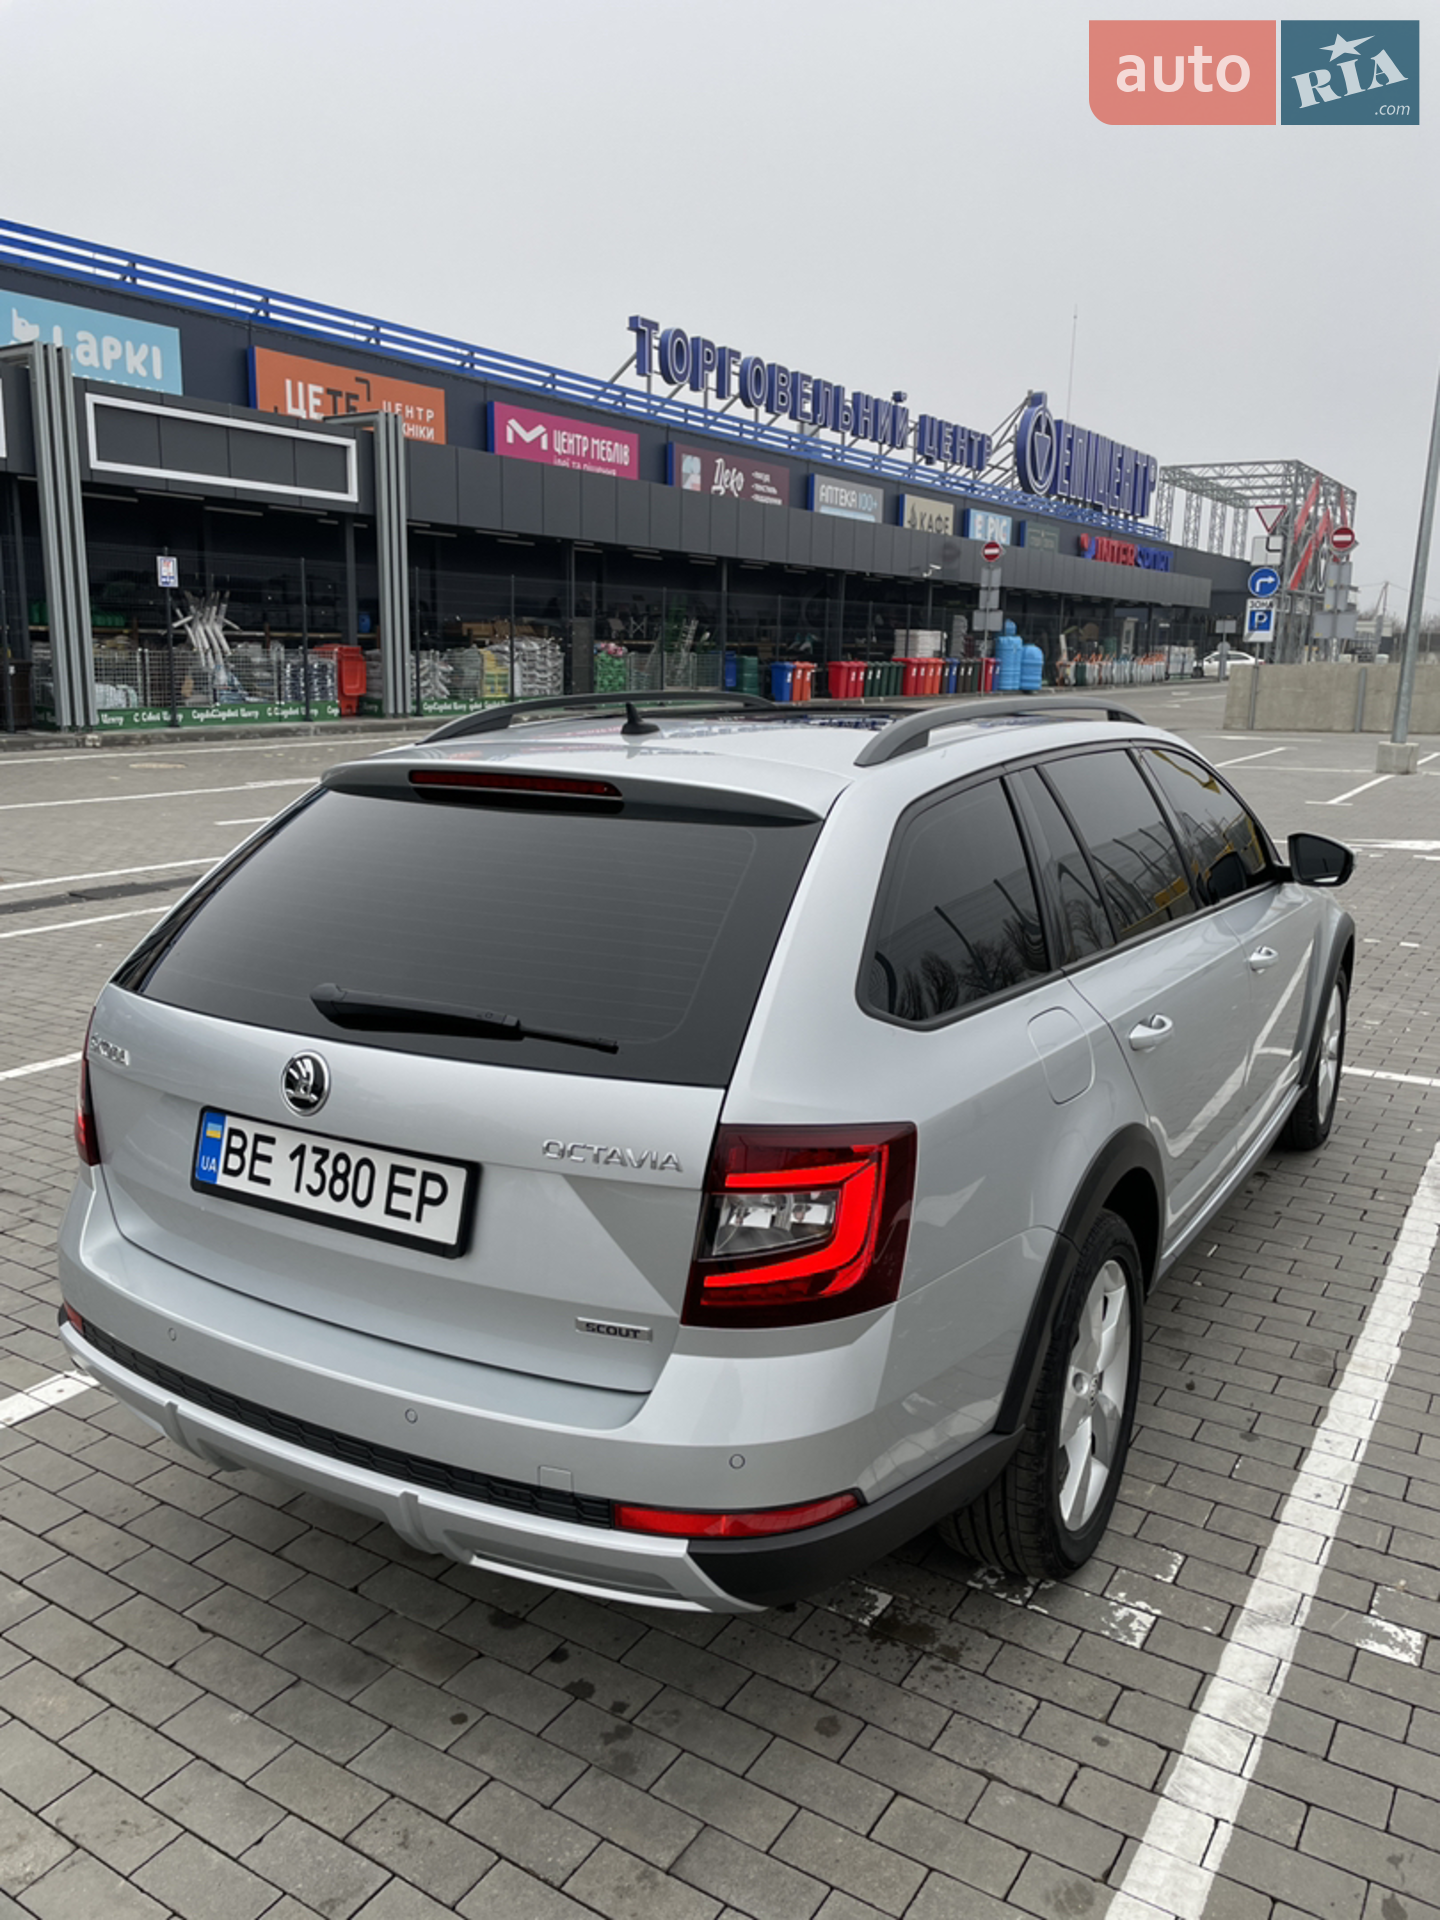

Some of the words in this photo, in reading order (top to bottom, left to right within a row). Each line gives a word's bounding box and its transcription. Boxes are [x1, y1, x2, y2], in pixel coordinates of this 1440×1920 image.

[628, 315, 909, 449] ТОРГОВЕЛЬНИЙ
[553, 429, 588, 457] ЦЕНТР
[590, 437, 631, 466] МЕБЛІВ
[917, 414, 993, 471] ЦЕНТР
[711, 458, 745, 497] Деко
[1053, 419, 1158, 518] ЕПІЦЕНТР
[820, 484, 858, 509] АПТЕКА
[920, 511, 951, 535] КАФЕ
[1249, 600, 1274, 609] ЗОНА
[201, 1155, 217, 1174] UA
[542, 1139, 684, 1173] OCTAVIA
[222, 1127, 277, 1186] BE
[289, 1144, 376, 1208] 1380
[384, 1163, 449, 1223] EP
[585, 1322, 641, 1339] SCOUT
